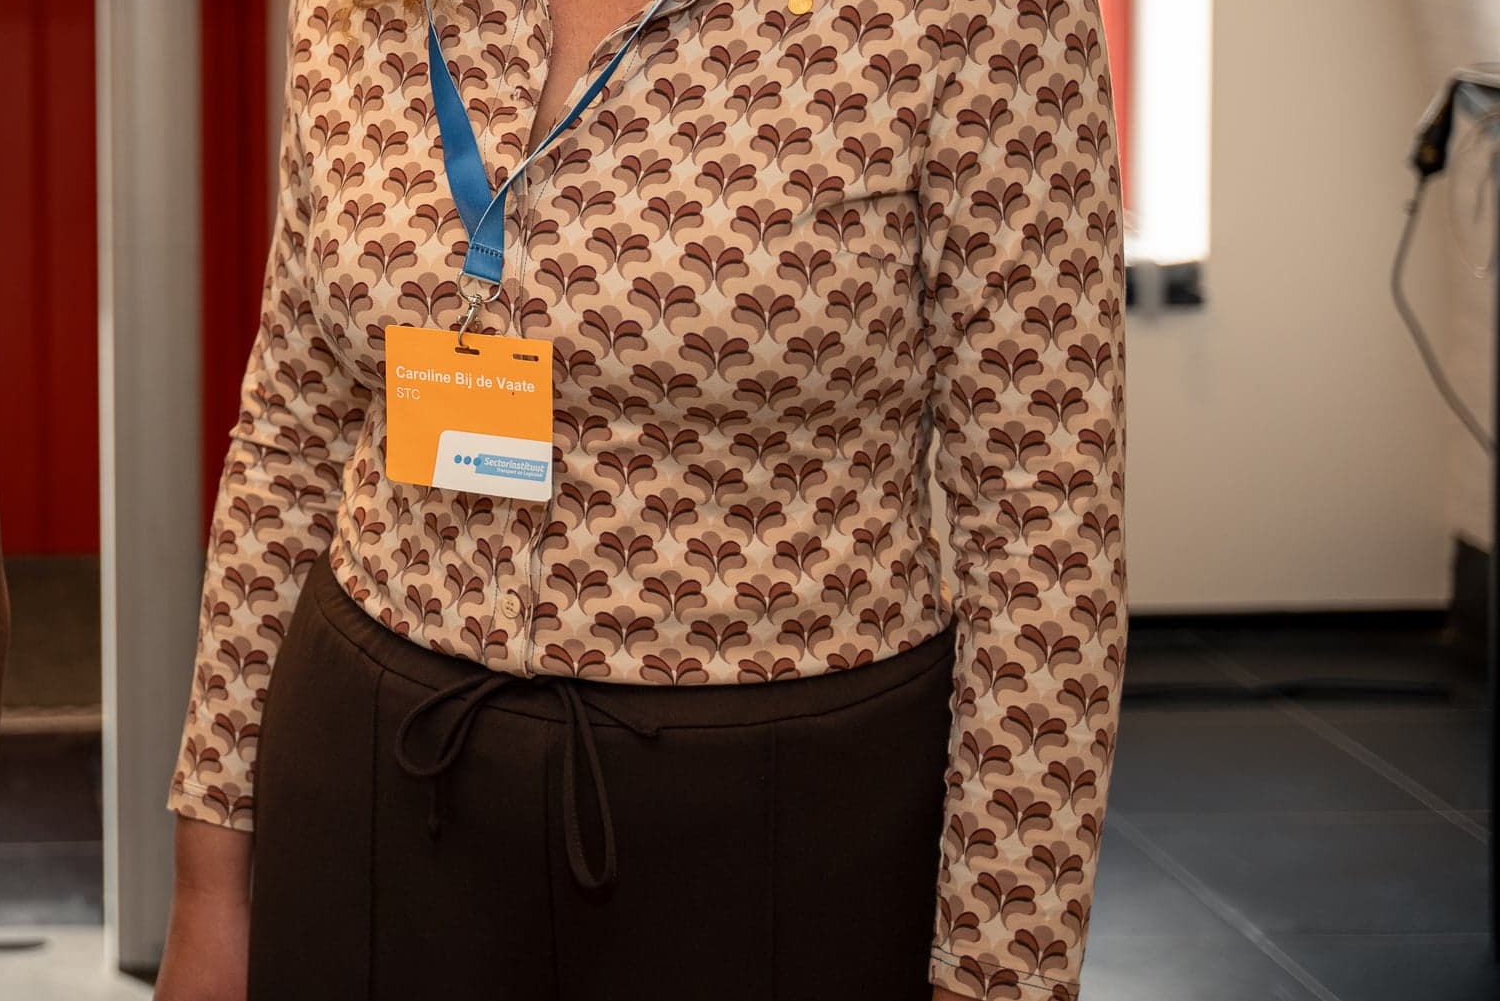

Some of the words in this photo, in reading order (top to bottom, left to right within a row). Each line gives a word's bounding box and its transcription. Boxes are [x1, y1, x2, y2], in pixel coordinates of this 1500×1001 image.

[395, 365, 451, 384] Caroline
[455, 371, 473, 389] Bij
[476, 375, 493, 388] de
[496, 376, 535, 393] Vaate
[396, 386, 421, 400] STC
